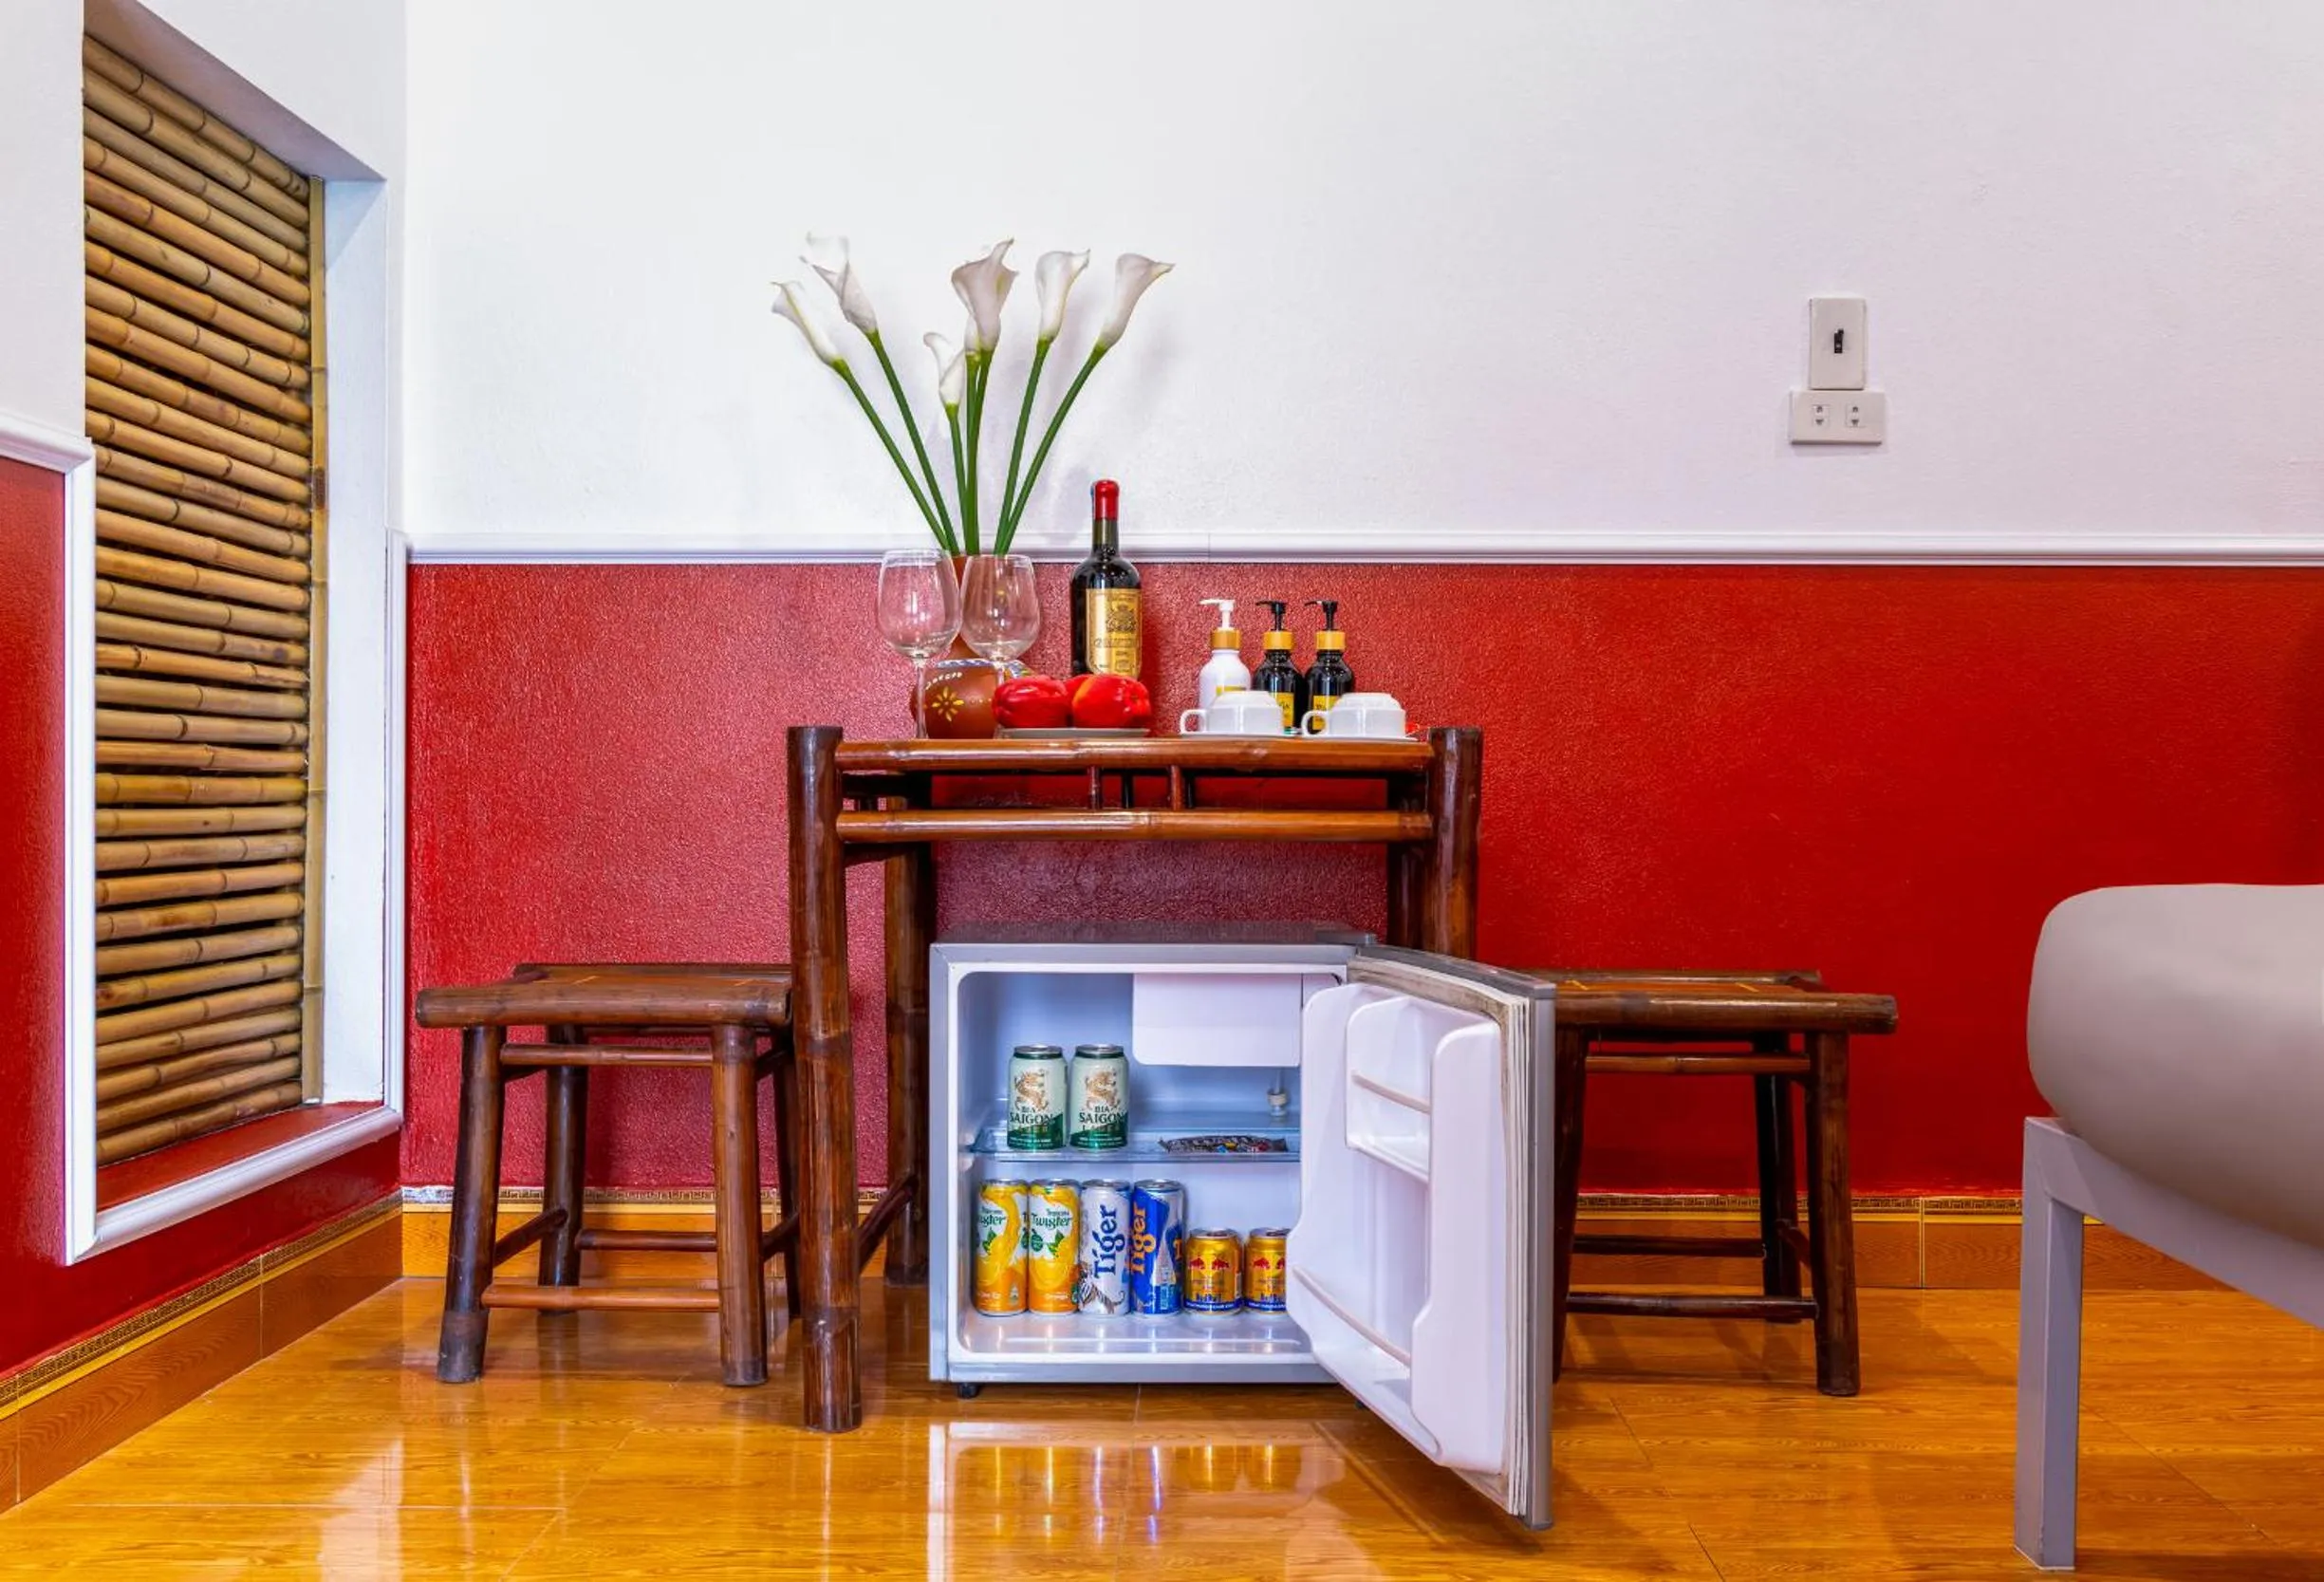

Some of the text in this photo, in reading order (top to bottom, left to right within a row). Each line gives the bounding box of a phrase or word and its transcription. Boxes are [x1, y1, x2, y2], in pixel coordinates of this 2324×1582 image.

[1009, 1112, 1052, 1124] SAIGON
[1079, 1111, 1125, 1124] SAIGON
[1091, 1204, 1125, 1278] Tiger
